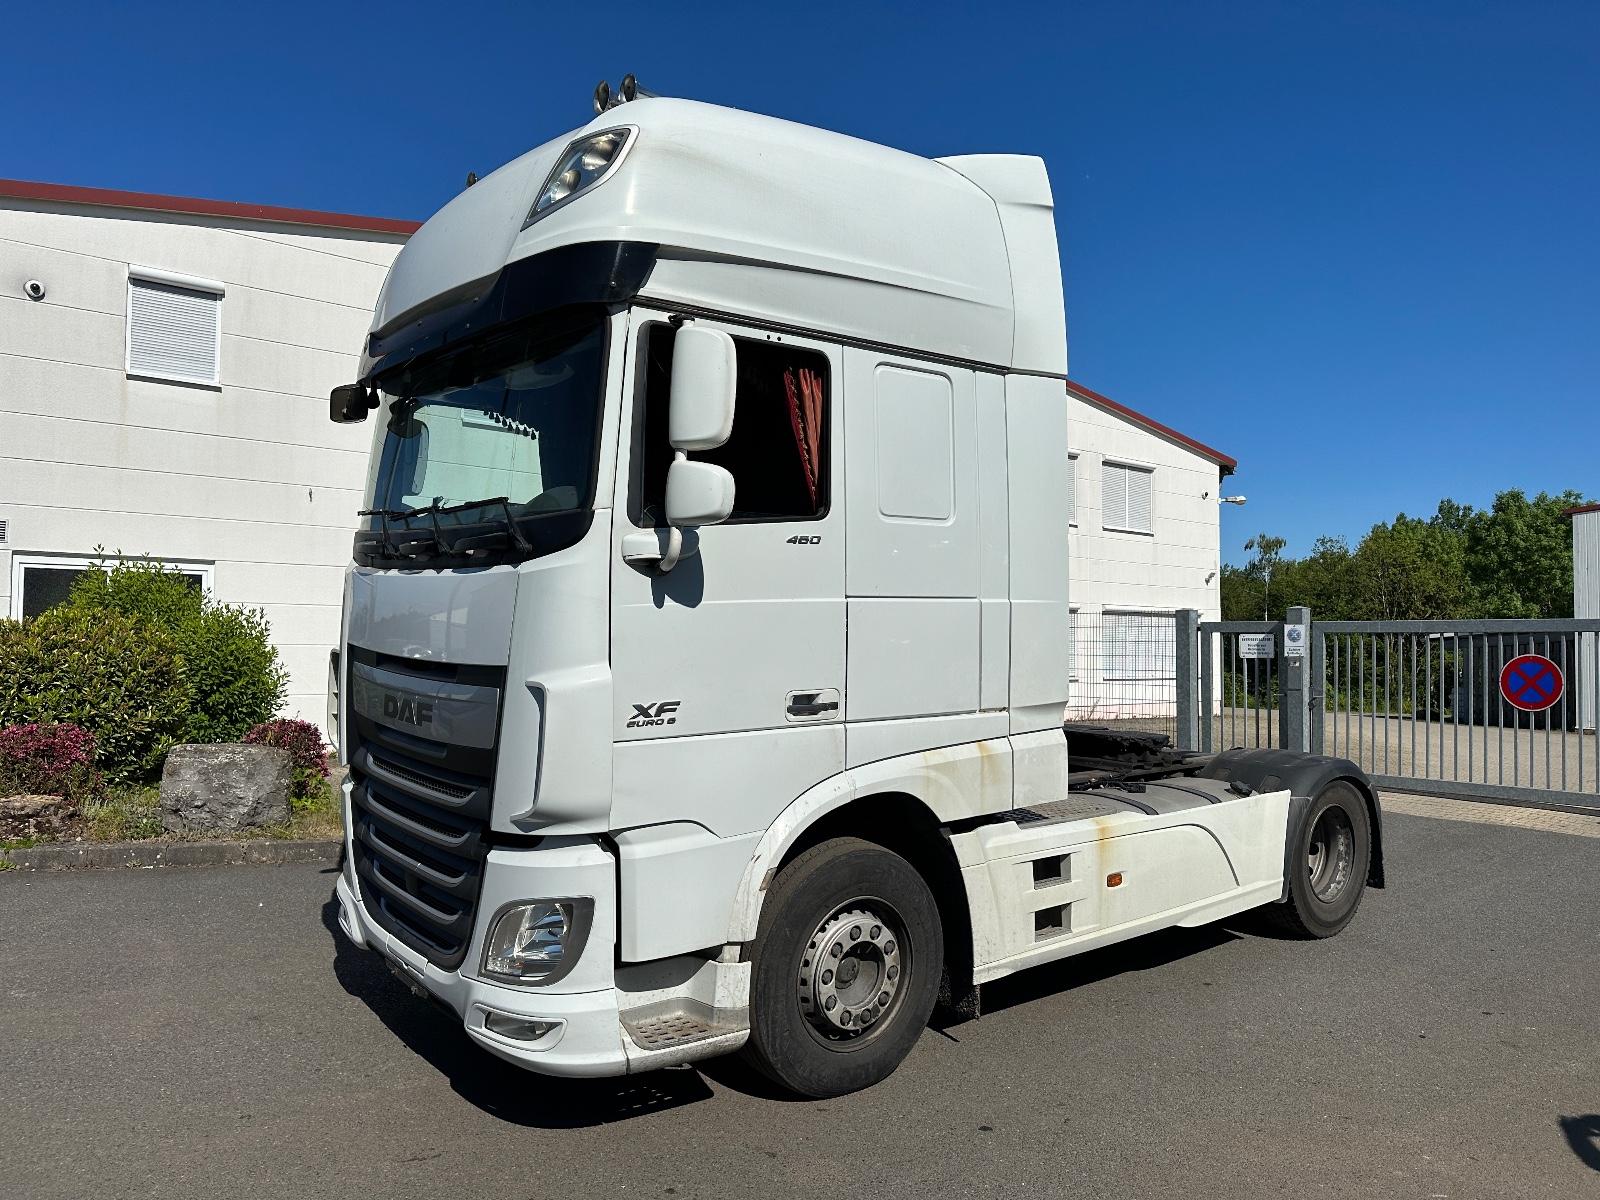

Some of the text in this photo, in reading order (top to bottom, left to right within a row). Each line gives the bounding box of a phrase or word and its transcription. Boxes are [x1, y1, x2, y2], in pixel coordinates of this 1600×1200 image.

[786, 535, 821, 545] 460
[384, 694, 433, 726] DAF
[628, 701, 681, 720] XF
[626, 717, 677, 728] EURO 6
